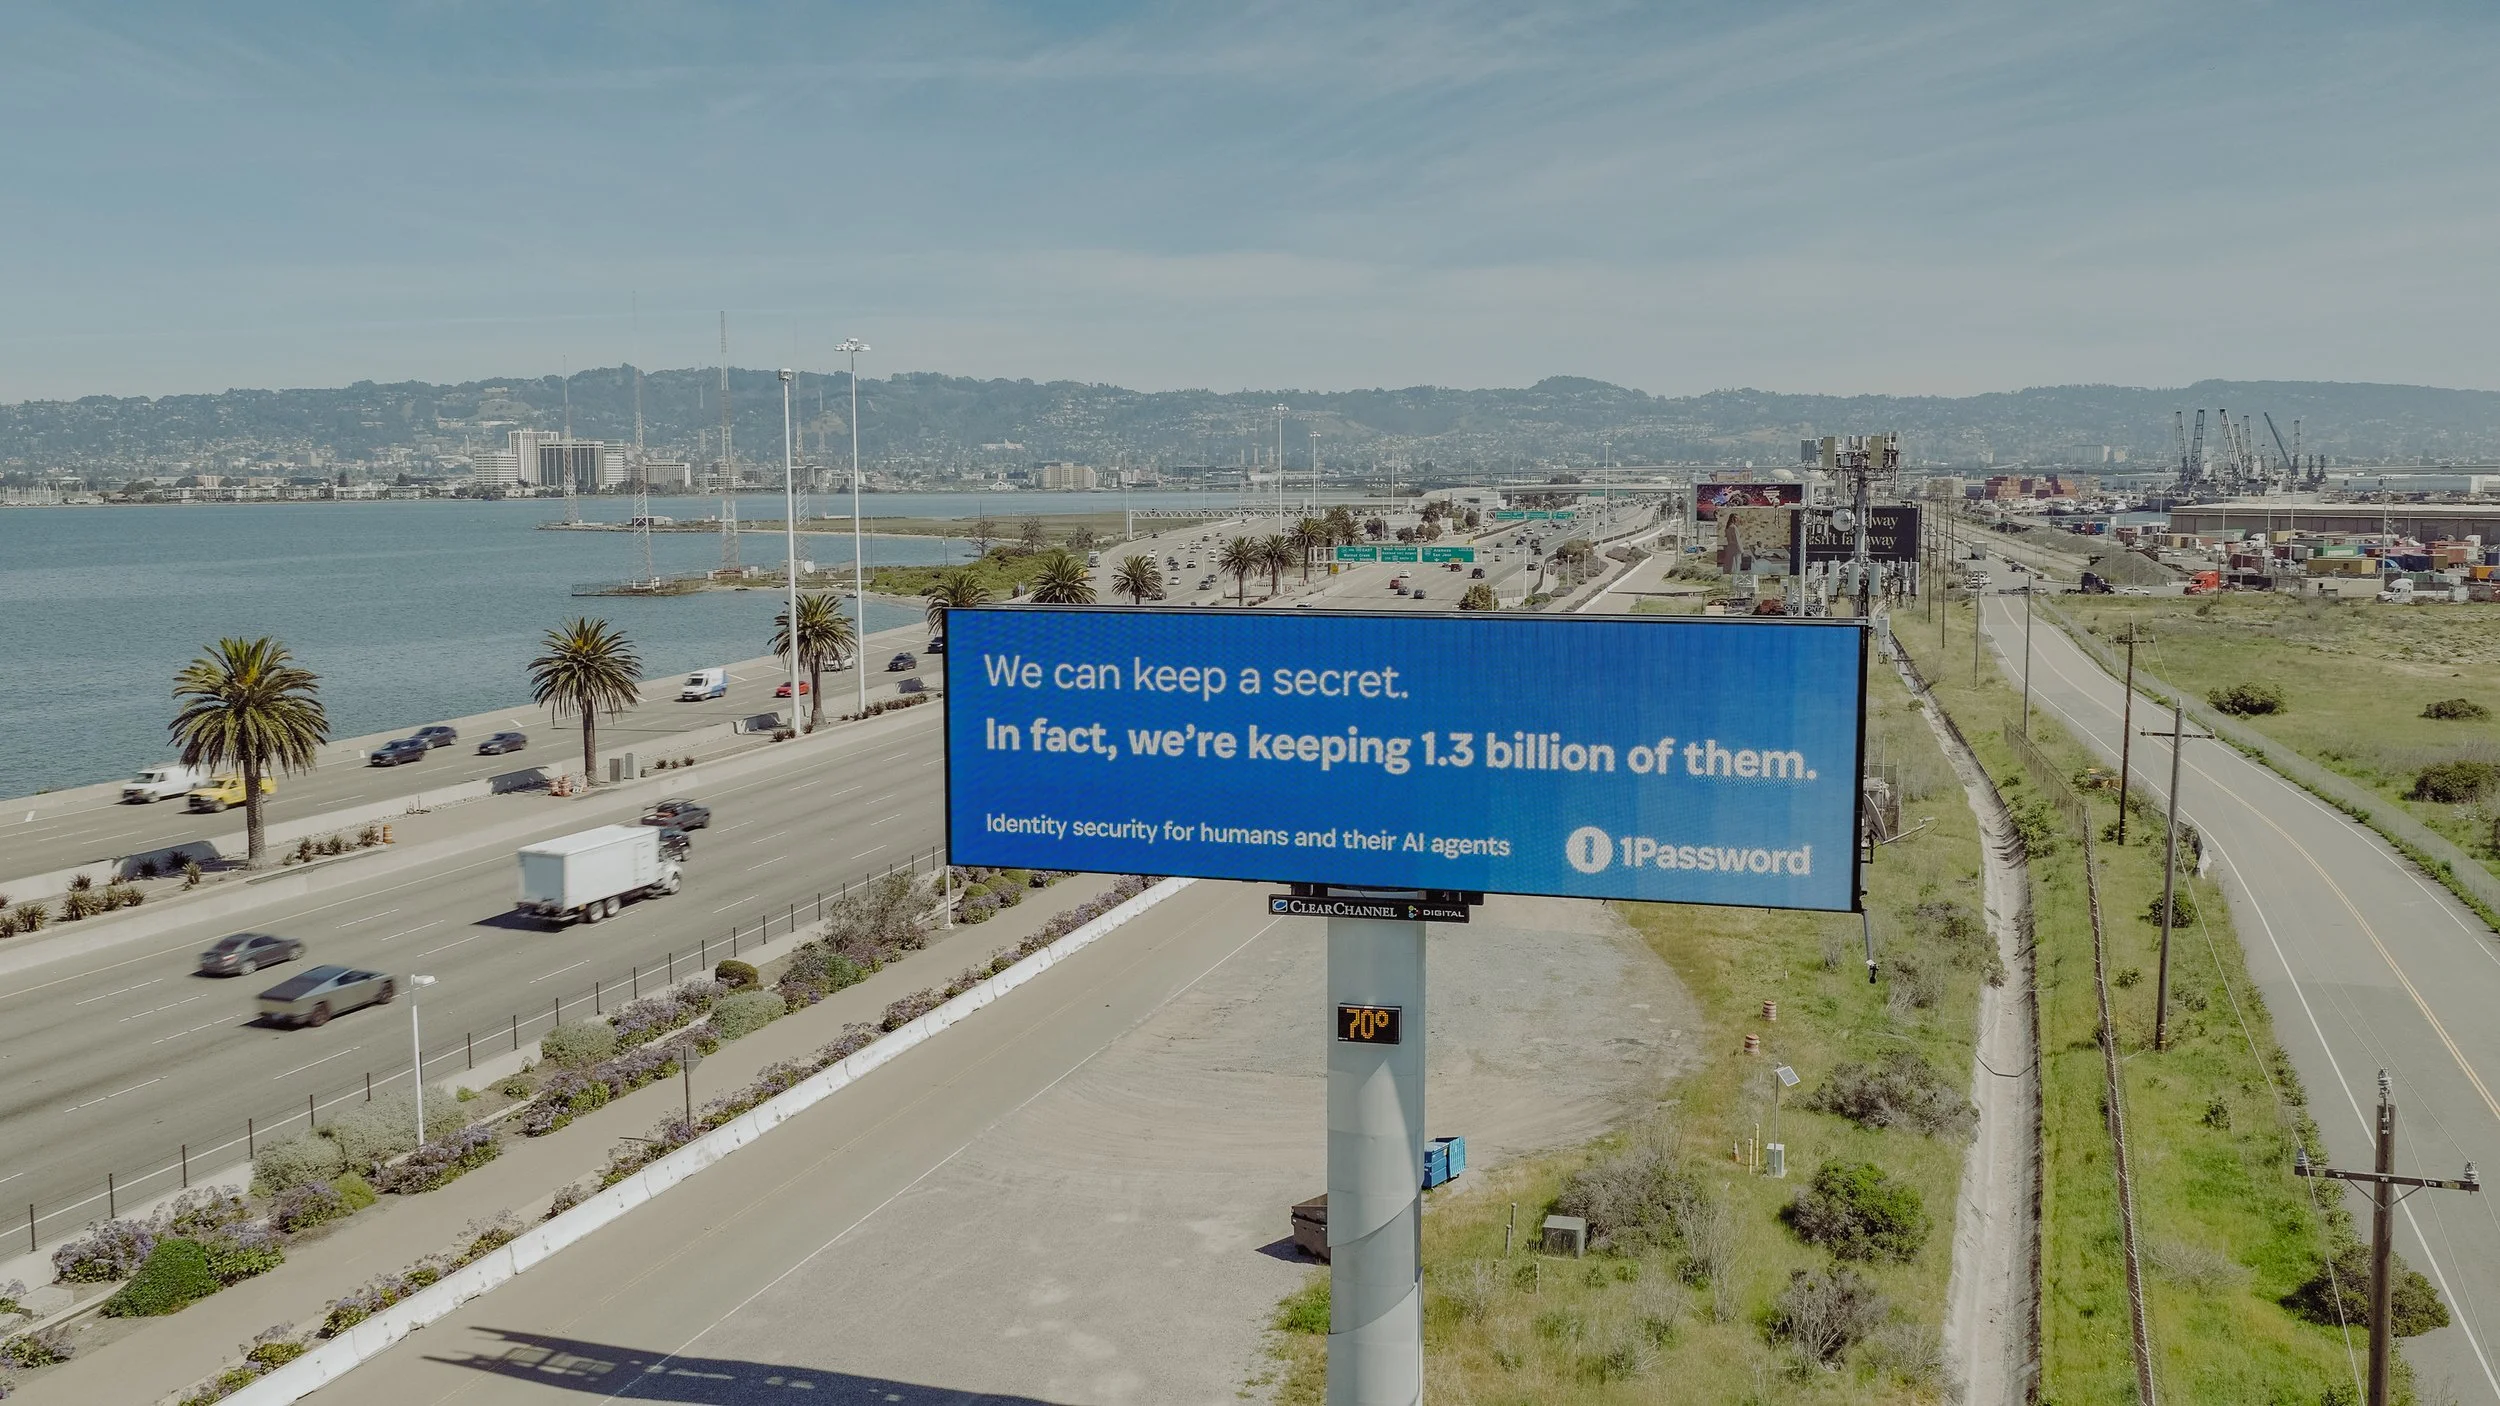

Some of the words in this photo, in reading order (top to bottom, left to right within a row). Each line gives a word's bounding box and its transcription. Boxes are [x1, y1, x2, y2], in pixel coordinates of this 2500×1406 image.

[1867, 536, 1897, 549] way
[984, 654, 1043, 689] We
[1054, 663, 1121, 690] can
[1134, 656, 1227, 702] keep
[1239, 668, 1261, 695] a
[1273, 666, 1409, 700] secret.
[986, 717, 1021, 751] In
[1029, 717, 1118, 761] fact,
[1128, 724, 1237, 760] we're
[1249, 725, 1412, 775] keeping
[1422, 731, 1475, 768] 1.3
[1486, 732, 1616, 773] billion
[1626, 736, 1677, 775] of
[1682, 738, 1819, 782] them.
[986, 813, 1068, 840] Identity
[1072, 818, 1158, 844] security
[1163, 820, 1193, 842] for
[1200, 822, 1289, 848] humans
[1294, 827, 1337, 849] and
[1342, 829, 1397, 852] their
[1402, 832, 1425, 853] AI
[1430, 837, 1511, 860] agents
[1620, 836, 1814, 876] 1Password
[1422, 908, 1465, 918] DIGITAL
[1346, 1008, 1389, 1040] 70°
